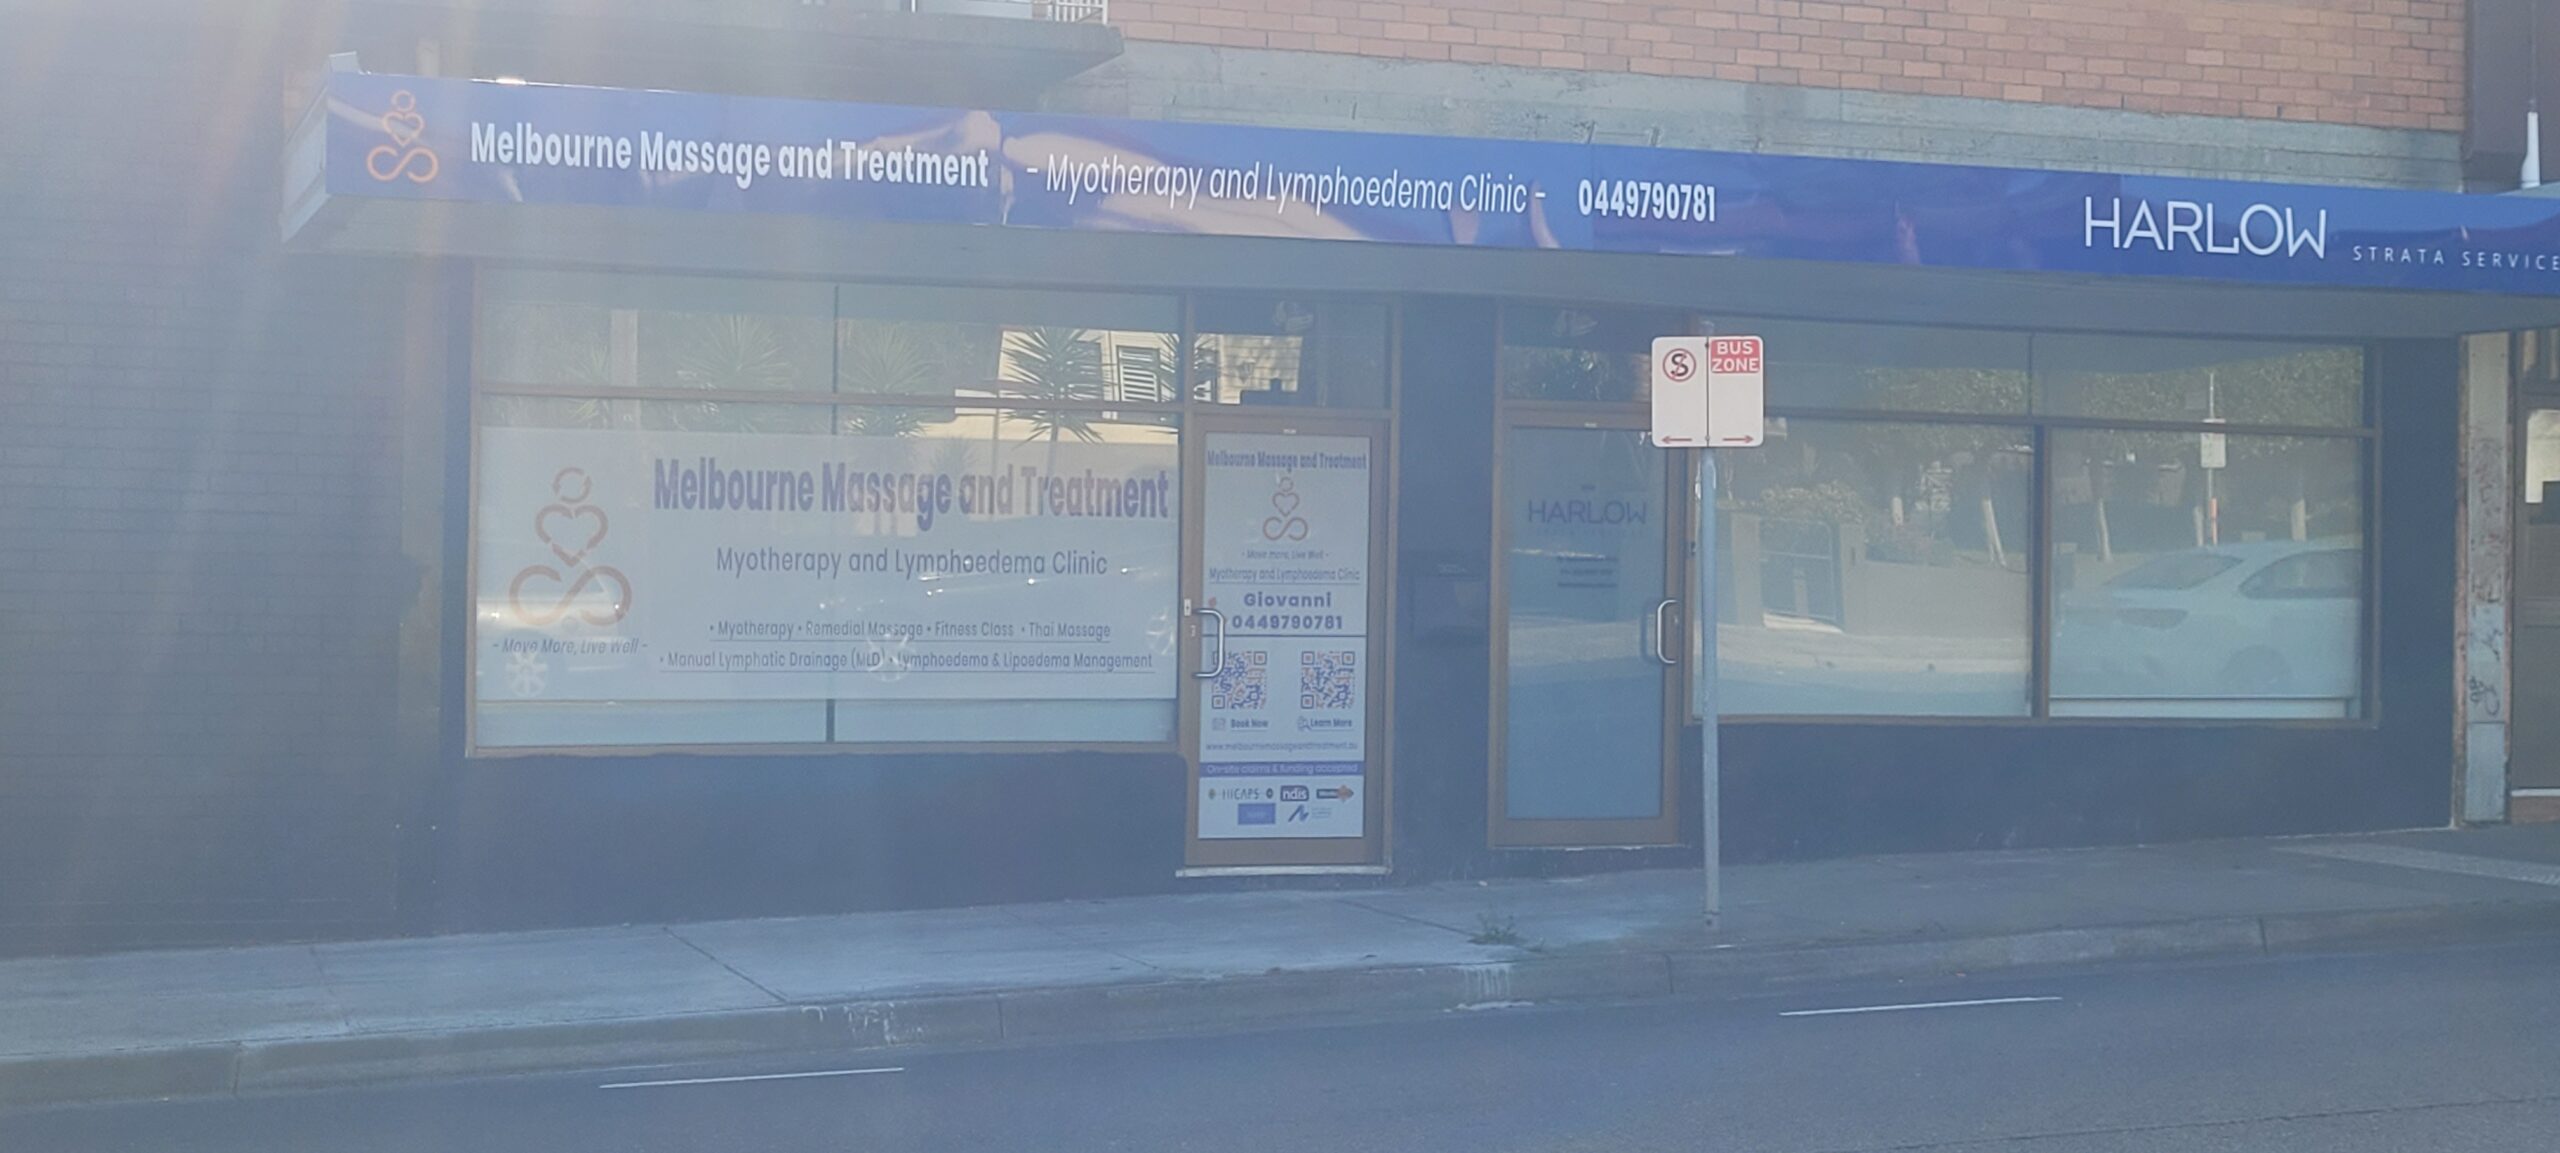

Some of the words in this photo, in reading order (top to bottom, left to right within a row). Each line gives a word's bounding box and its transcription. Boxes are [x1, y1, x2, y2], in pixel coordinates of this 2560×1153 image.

[470, 121, 632, 172] Melbourne
[640, 129, 772, 190] Massage
[777, 138, 834, 179] and
[840, 142, 989, 188] Treatment
[1045, 153, 1204, 210] Myotherapy
[1208, 161, 1260, 200] and
[1265, 162, 1452, 216] Lymphoedema
[1459, 173, 1527, 213] Clinic
[1578, 178, 1717, 222] 0449790781
[2084, 195, 2327, 259] HARLOW
[2352, 245, 2445, 266] STRATA
[2462, 251, 2560, 271] SERVICE
[1717, 341, 1753, 355] BUS
[1711, 358, 1759, 372] ZONE
[1207, 450, 1256, 467] Melbourne
[1257, 451, 1298, 473] Massage
[1300, 453, 1317, 468] and
[1319, 453, 1367, 469] Treatment
[654, 458, 814, 512] Melbourne
[821, 461, 953, 531] Massage
[958, 464, 1014, 515] and
[1020, 466, 1169, 519] Treatment
[1528, 499, 1647, 525] HARLOW
[716, 546, 841, 580] Myotherapy
[849, 548, 888, 573] and
[896, 548, 1045, 581] Lymphoedema
[1052, 550, 1108, 576] Clinic
[1209, 567, 1257, 582] Myotherapy
[1259, 568, 1275, 580] and
[1276, 568, 1336, 583] Lymphoedema
[1338, 568, 1360, 580] Clinic
[1243, 591, 1331, 608] Giovanni
[718, 620, 794, 641] Myotherapy
[806, 620, 865, 636] Remedial
[869, 621, 923, 641] Massage
[935, 622, 977, 636] Fitness
[981, 622, 1013, 636] Class
[1029, 622, 1054, 637] Thai
[1057, 623, 1110, 642] Massage
[1232, 615, 1343, 630] 0449790781
[502, 638, 539, 653] Move
[541, 638, 577, 656] More,
[580, 638, 607, 654] Live
[609, 637, 640, 654] Well
[668, 652, 716, 668] Manual
[719, 652, 785, 671] Lymphatic
[790, 652, 847, 671] Drainage
[851, 648, 885, 670] (MLD)
[899, 651, 988, 672] Lymphoedema
[992, 652, 1000, 667] &
[1003, 652, 1070, 671] Lipoedema
[1074, 653, 1152, 672] Management
[1231, 719, 1249, 728] Book
[1333, 718, 1352, 727] More
[1279, 763, 1314, 775] funding
